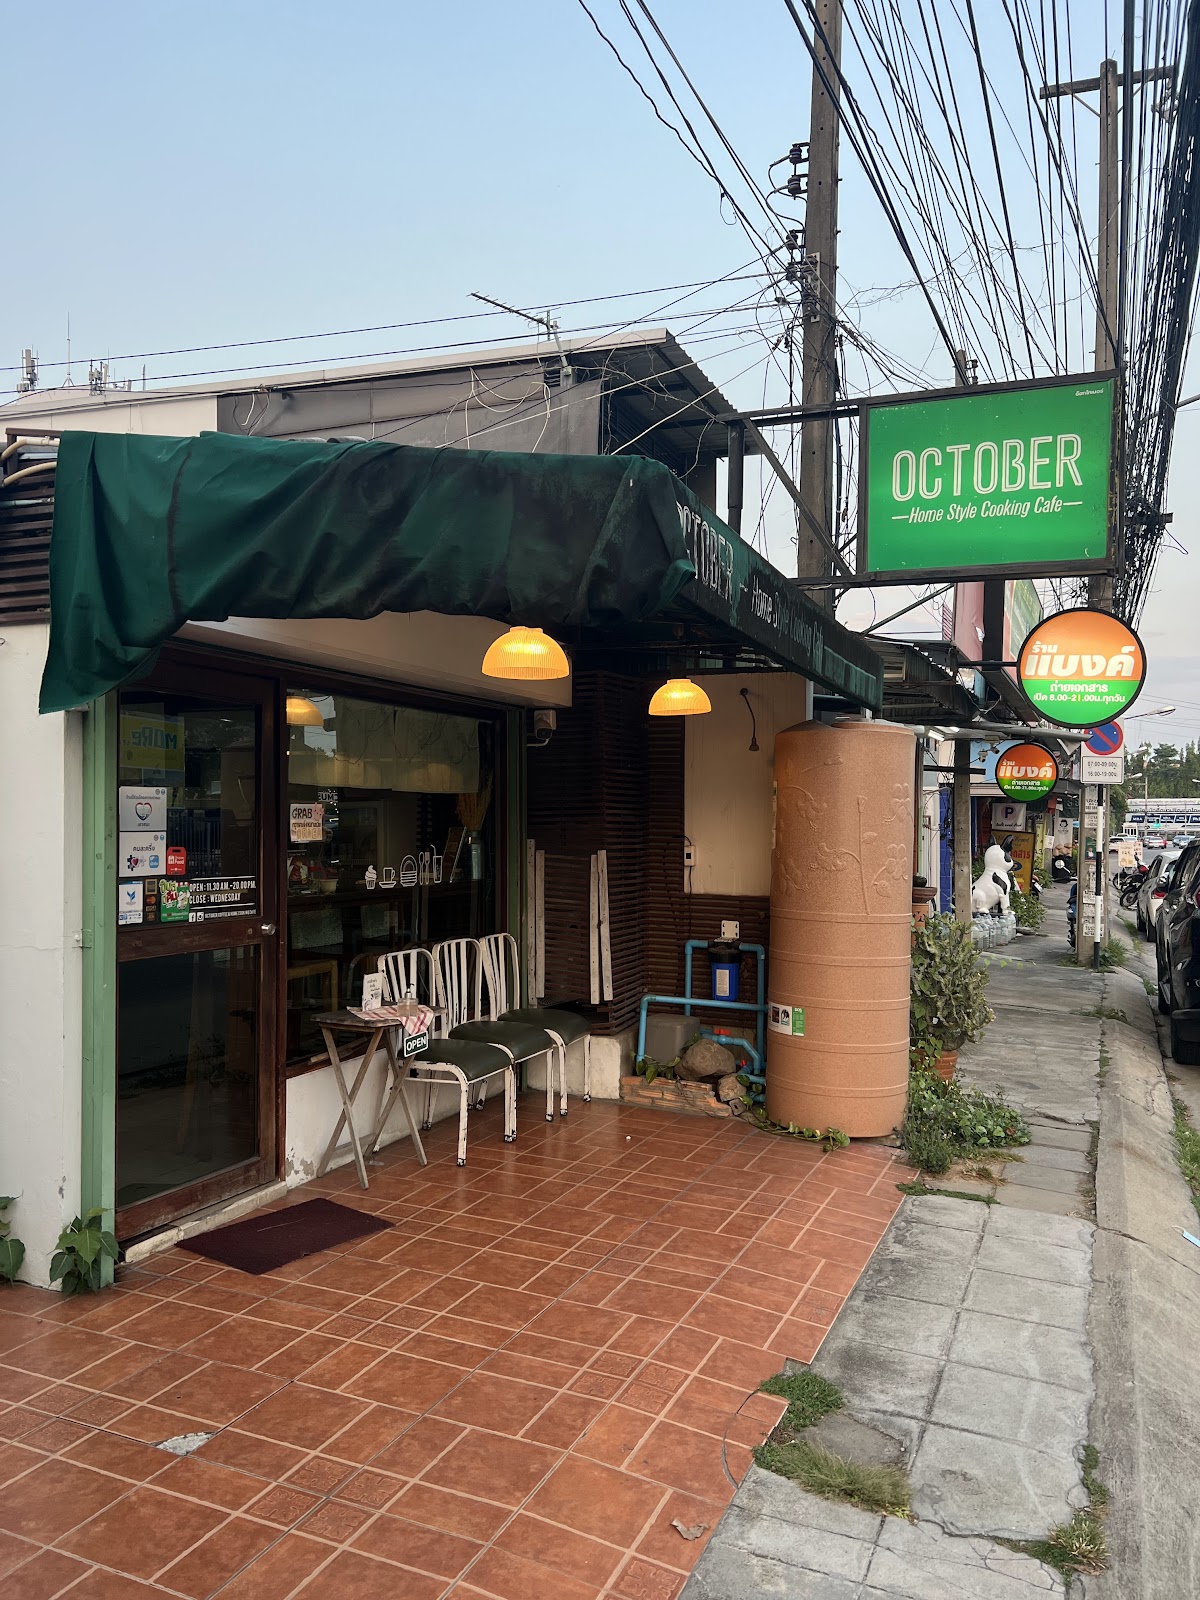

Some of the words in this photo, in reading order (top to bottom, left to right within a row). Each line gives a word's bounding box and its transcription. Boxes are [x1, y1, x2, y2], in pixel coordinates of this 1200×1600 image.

[892, 434, 1083, 502] OCTOBER
[908, 507, 944, 523] Home
[947, 502, 977, 523] Style
[981, 499, 1030, 518] Cooking
[1034, 495, 1063, 514] Cafe
[751, 575, 773, 624] Home
[1032, 641, 1058, 653] ร้าน
[1025, 645, 1136, 677] แบงค์
[1050, 680, 1108, 693] ถ่ายเอกสาร
[999, 762, 1053, 778] แบงค์
[292, 807, 313, 819] GRAB
[1005, 806, 1014, 818] P
[210, 892, 241, 903] WEDNESDAY
[406, 1036, 427, 1051] OPEN
